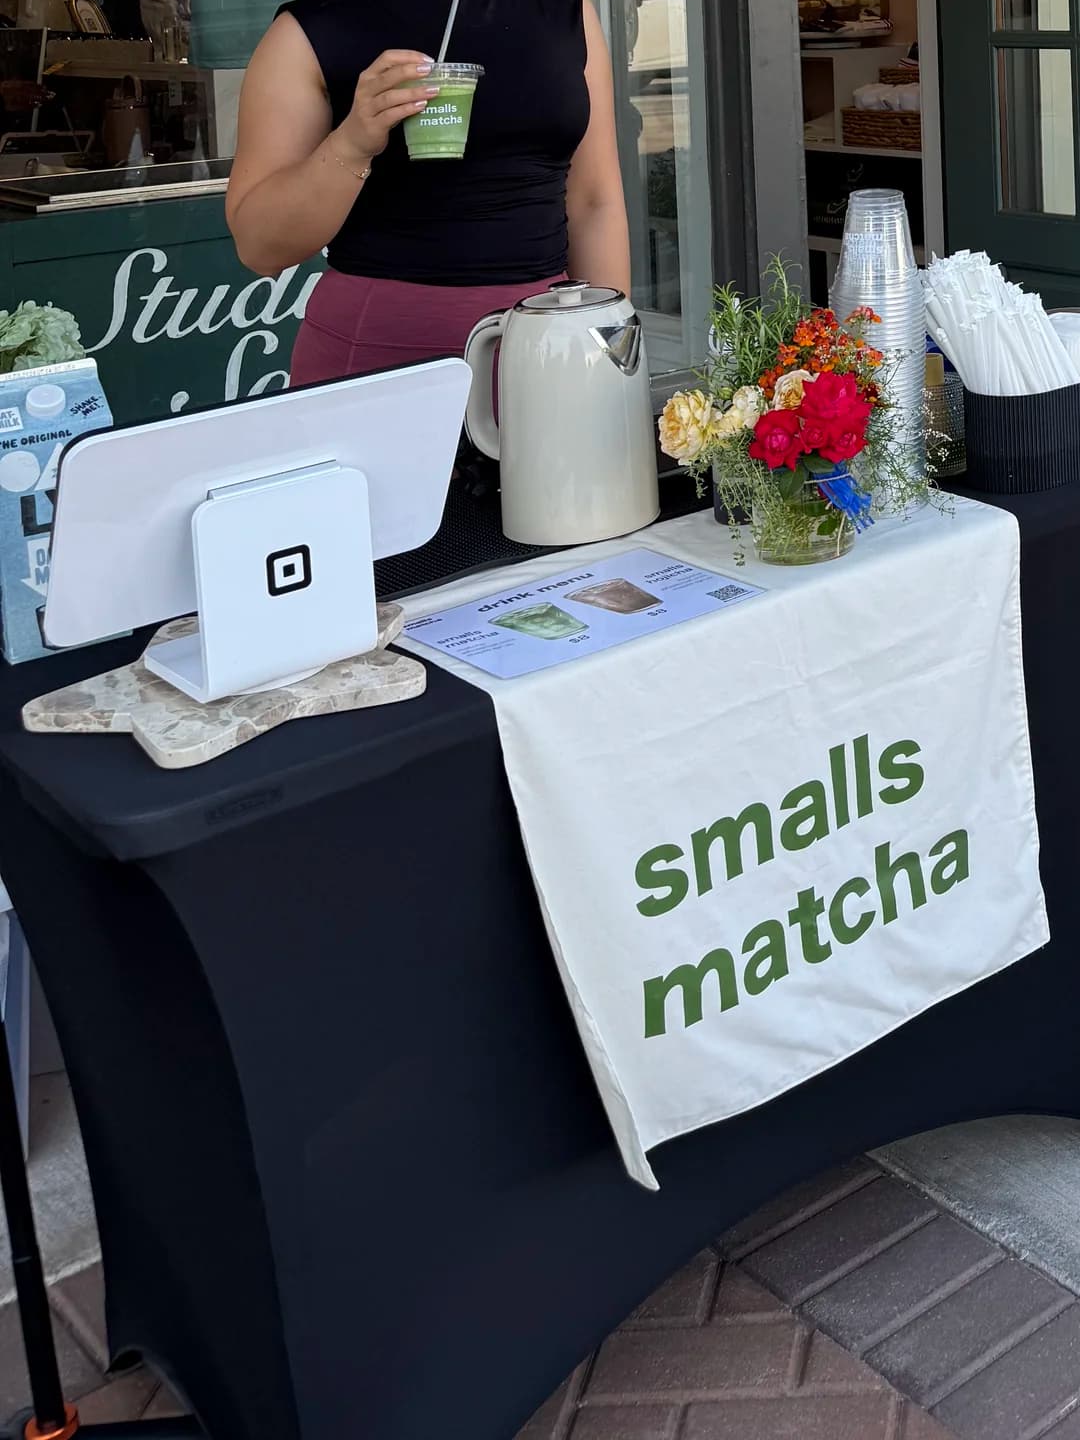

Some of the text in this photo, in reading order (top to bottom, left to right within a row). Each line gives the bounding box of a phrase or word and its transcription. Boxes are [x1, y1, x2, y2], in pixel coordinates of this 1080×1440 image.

[420, 115, 463, 127] matcha
[70, 396, 98, 415] SHAKE
[21, 429, 73, 446] ORIGINAL
[643, 563, 684, 580] smalls
[645, 567, 693, 585] hojicha
[477, 572, 595, 613] drink menu
[437, 629, 482, 646] smalls
[445, 631, 500, 649] matcha
[634, 733, 925, 918] smalls
[643, 829, 970, 1039] matcha
